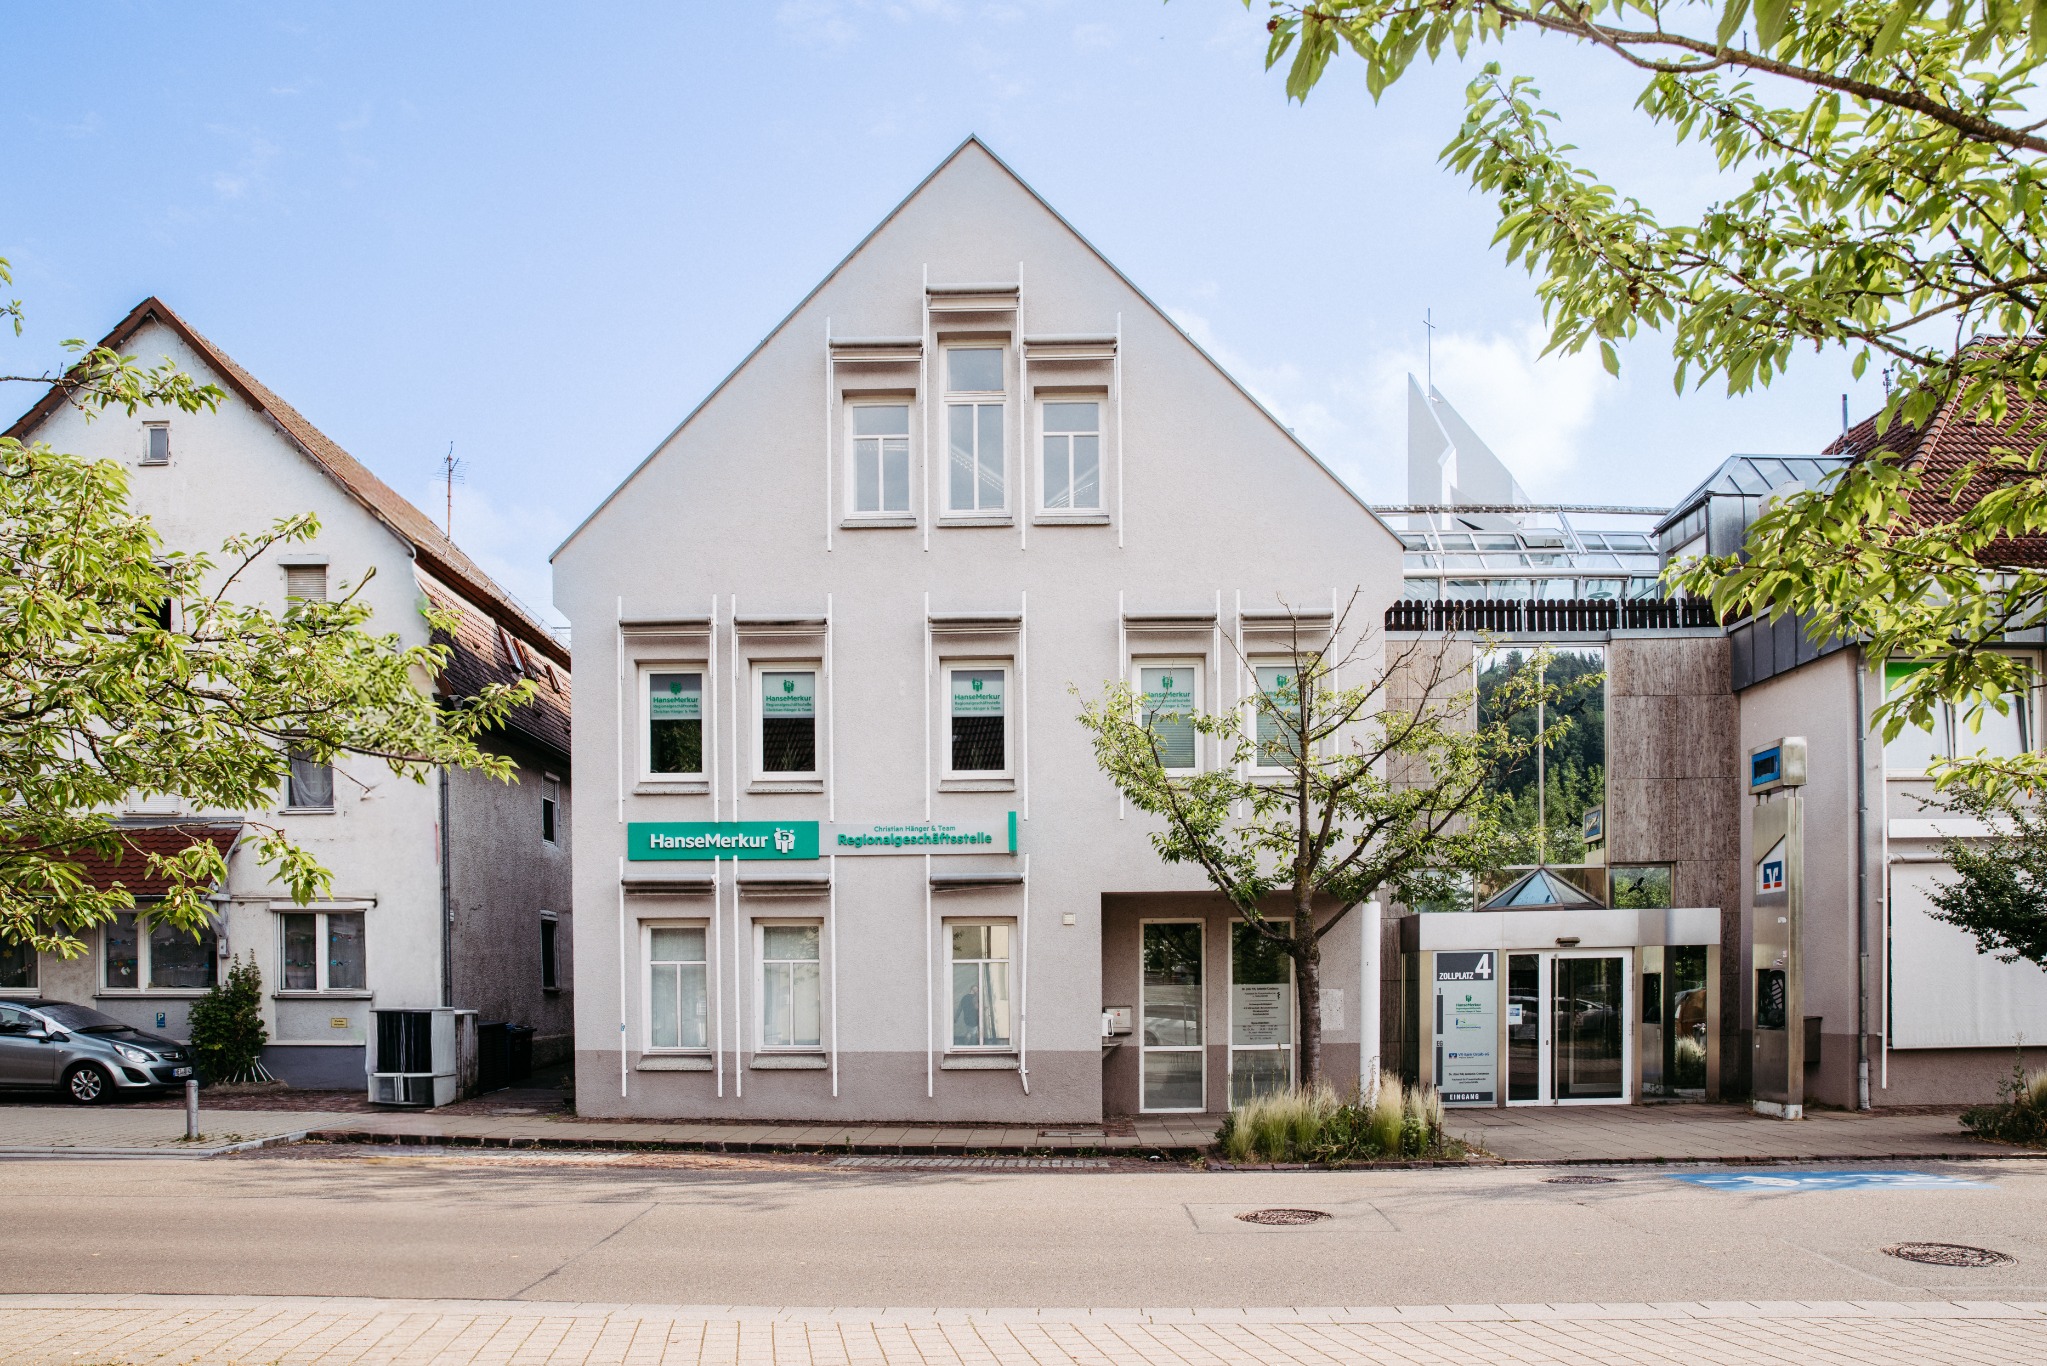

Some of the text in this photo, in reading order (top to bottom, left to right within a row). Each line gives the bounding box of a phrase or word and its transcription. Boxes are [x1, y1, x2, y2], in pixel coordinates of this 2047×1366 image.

[905, 825, 930, 833] Hänger
[650, 833, 768, 849] HanseMerkur
[837, 831, 993, 848] Regionalgeschäftsstelle
[1439, 953, 1492, 980] ZOLLPLATZ 4
[157, 1013, 164, 1021] P
